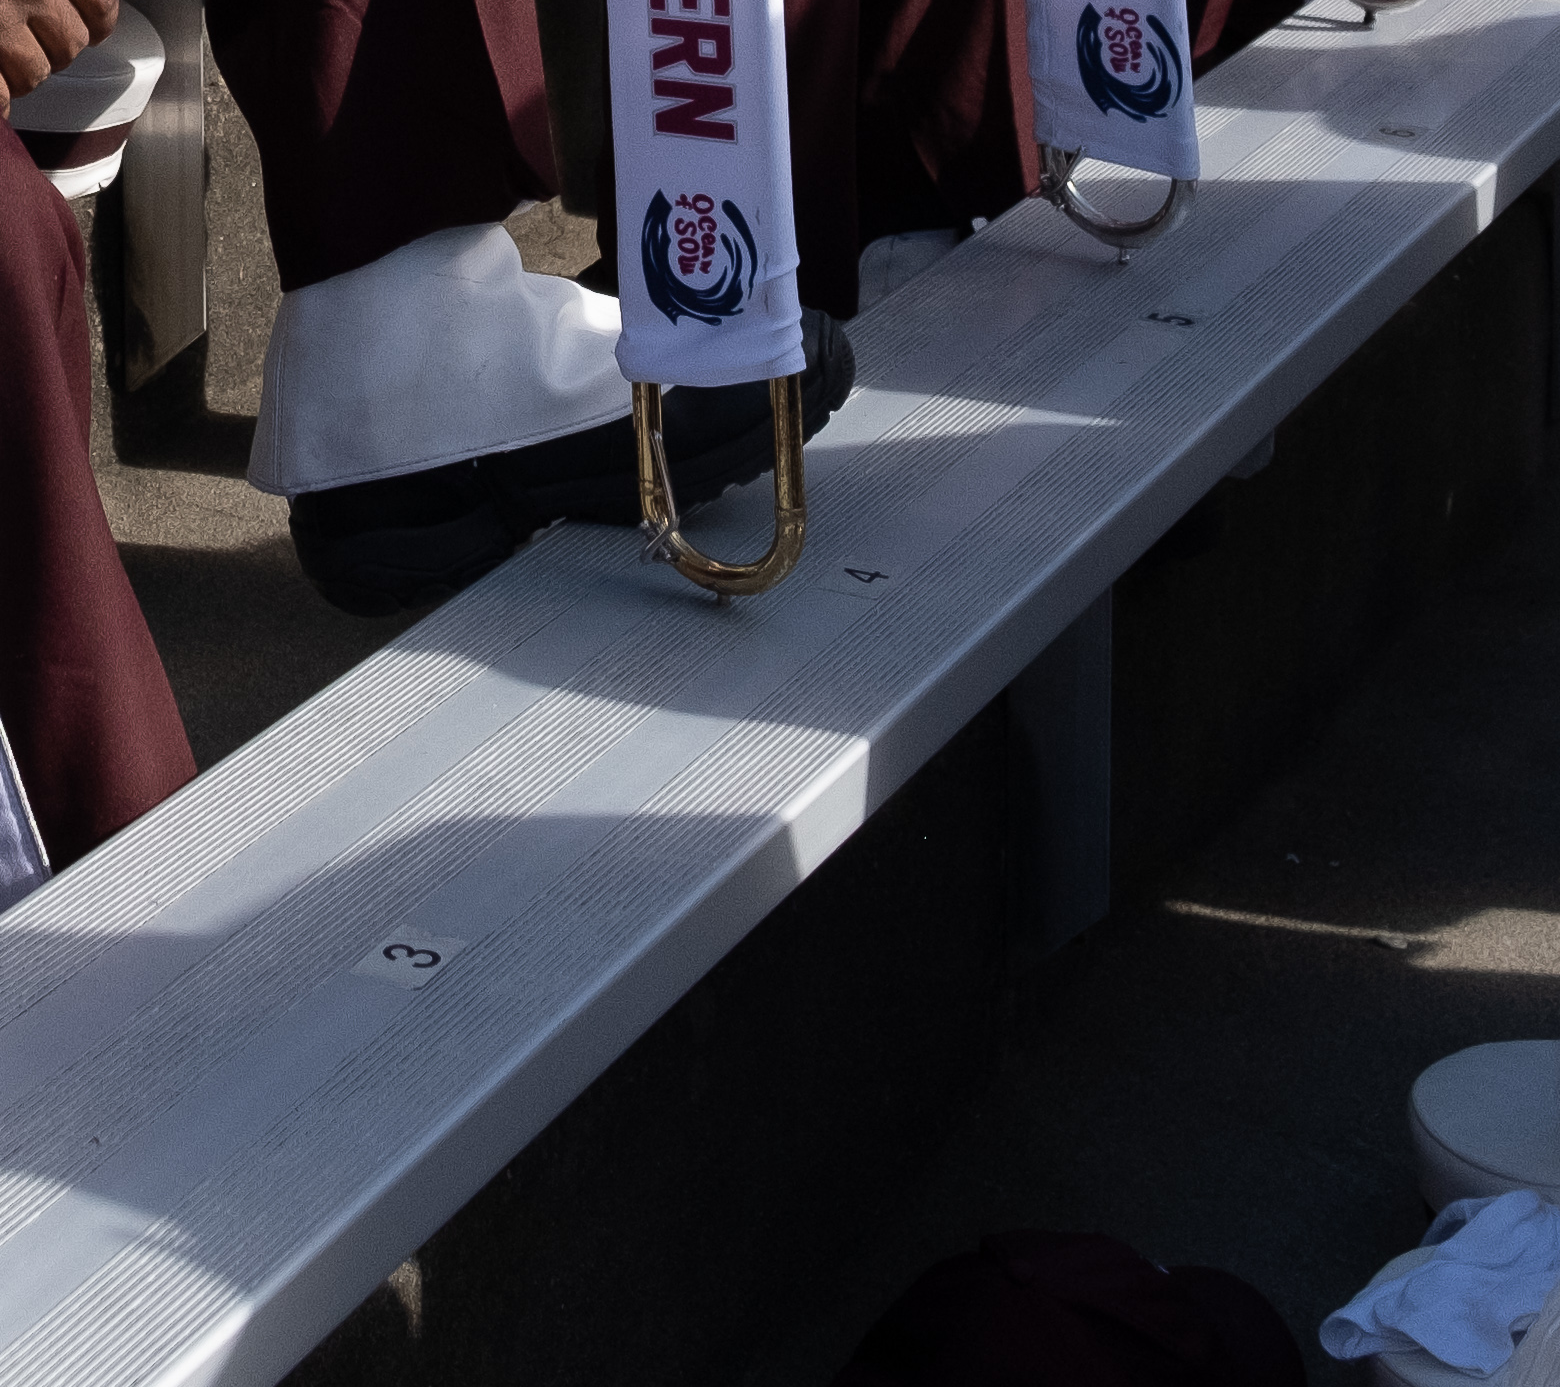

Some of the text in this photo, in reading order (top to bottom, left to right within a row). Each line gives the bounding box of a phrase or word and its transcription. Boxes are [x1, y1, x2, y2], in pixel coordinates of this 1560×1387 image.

[1146, 312, 1196, 327] 5
[843, 567, 890, 584] 4
[382, 943, 442, 970] 3
